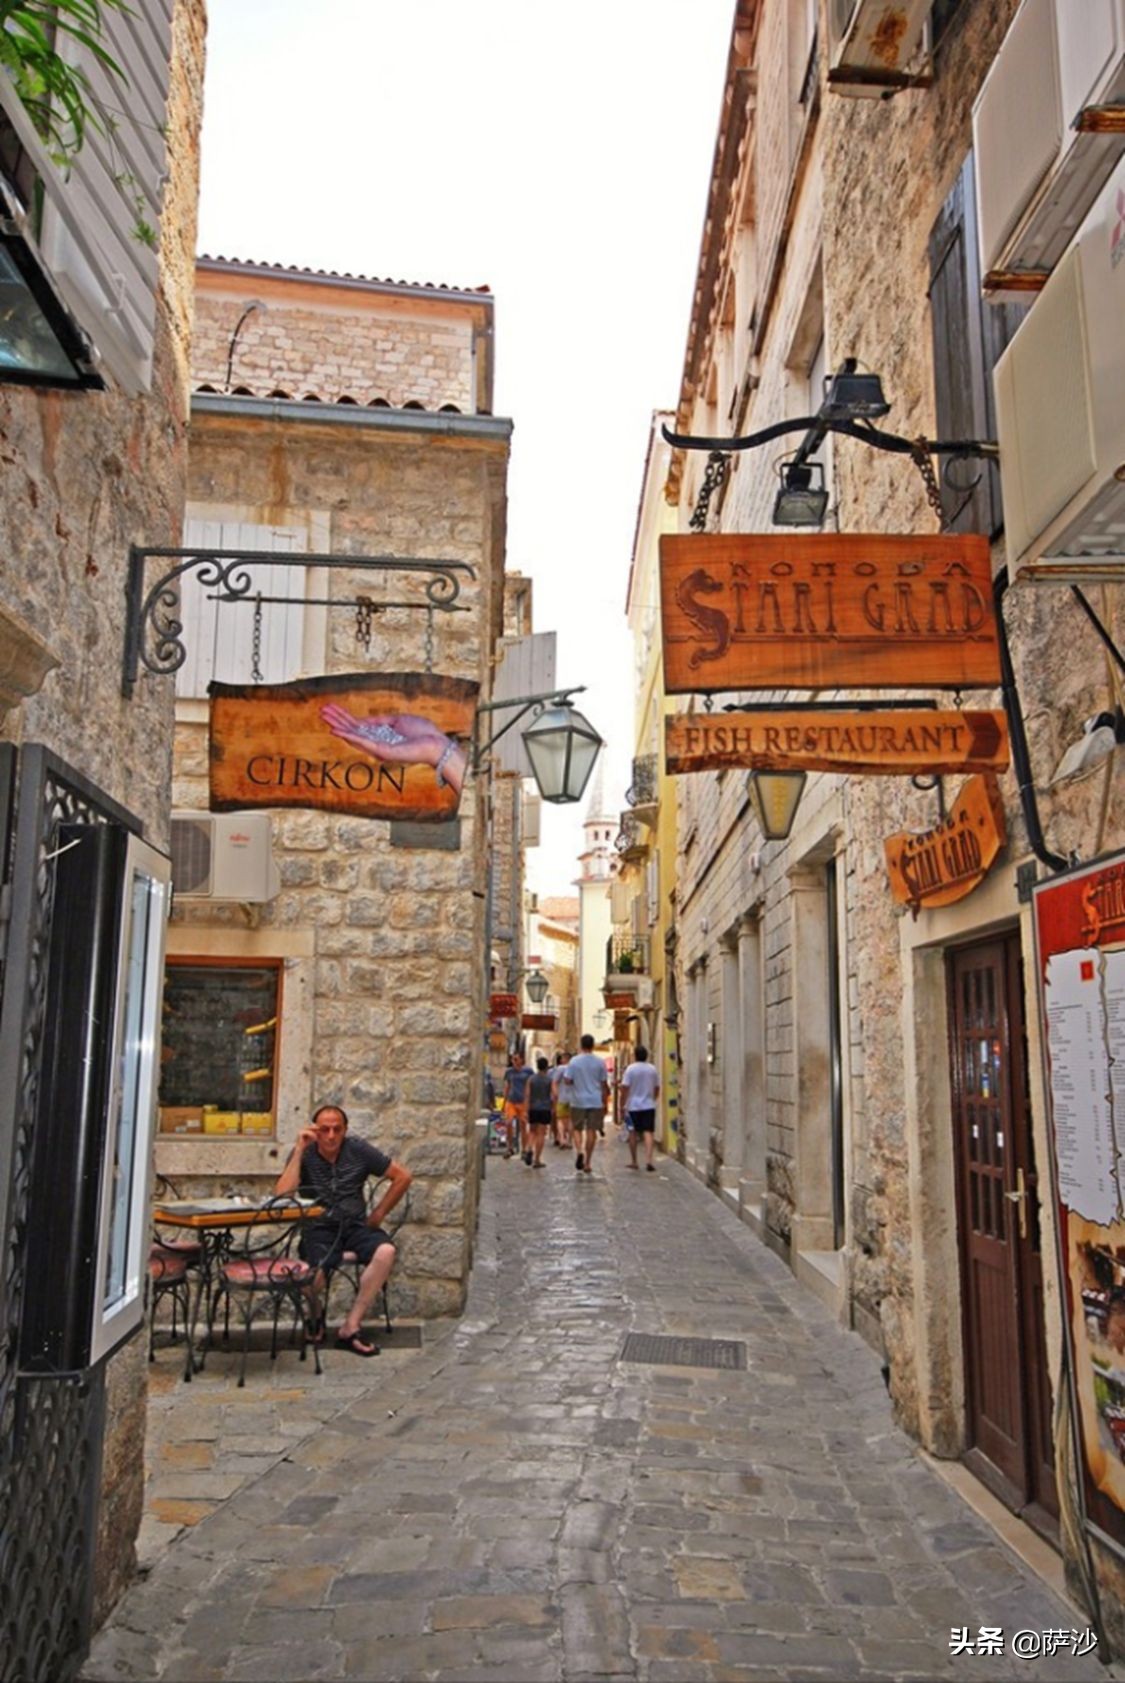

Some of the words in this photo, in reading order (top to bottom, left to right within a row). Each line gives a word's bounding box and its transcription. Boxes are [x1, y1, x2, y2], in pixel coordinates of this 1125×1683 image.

[864, 581, 986, 632] GRAD
[684, 726, 752, 751] FISH
[763, 724, 964, 752] RESTAURANT
[246, 755, 405, 793] CIRKON
